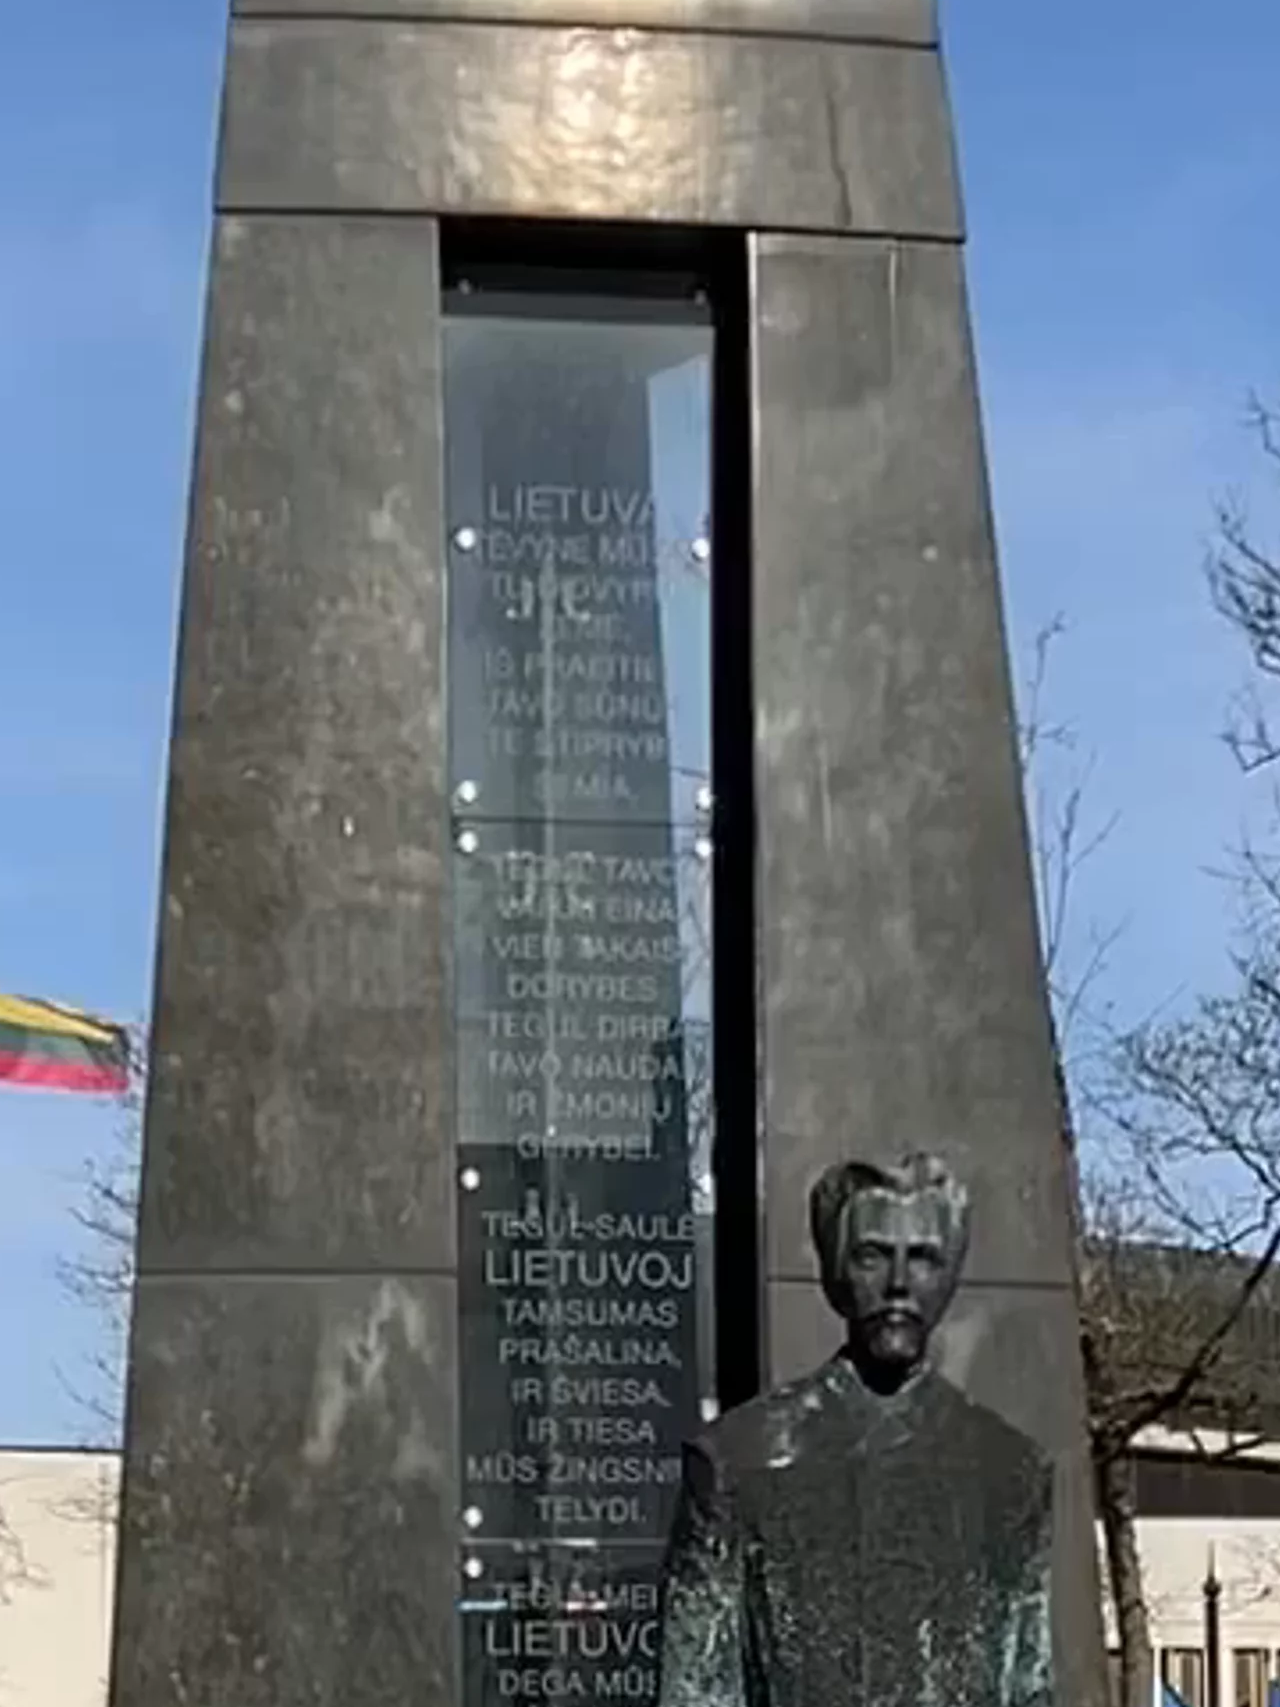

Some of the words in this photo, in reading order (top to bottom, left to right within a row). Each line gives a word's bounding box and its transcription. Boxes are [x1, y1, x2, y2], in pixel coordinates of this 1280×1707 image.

[485, 1249, 693, 1290] LIETUVOJ
[501, 1297, 680, 1329] TAMSUMAS
[510, 1377, 543, 1405] IR
[527, 1415, 560, 1444] IR
[566, 1416, 657, 1446] TIESA
[498, 1667, 588, 1697] DEGA
